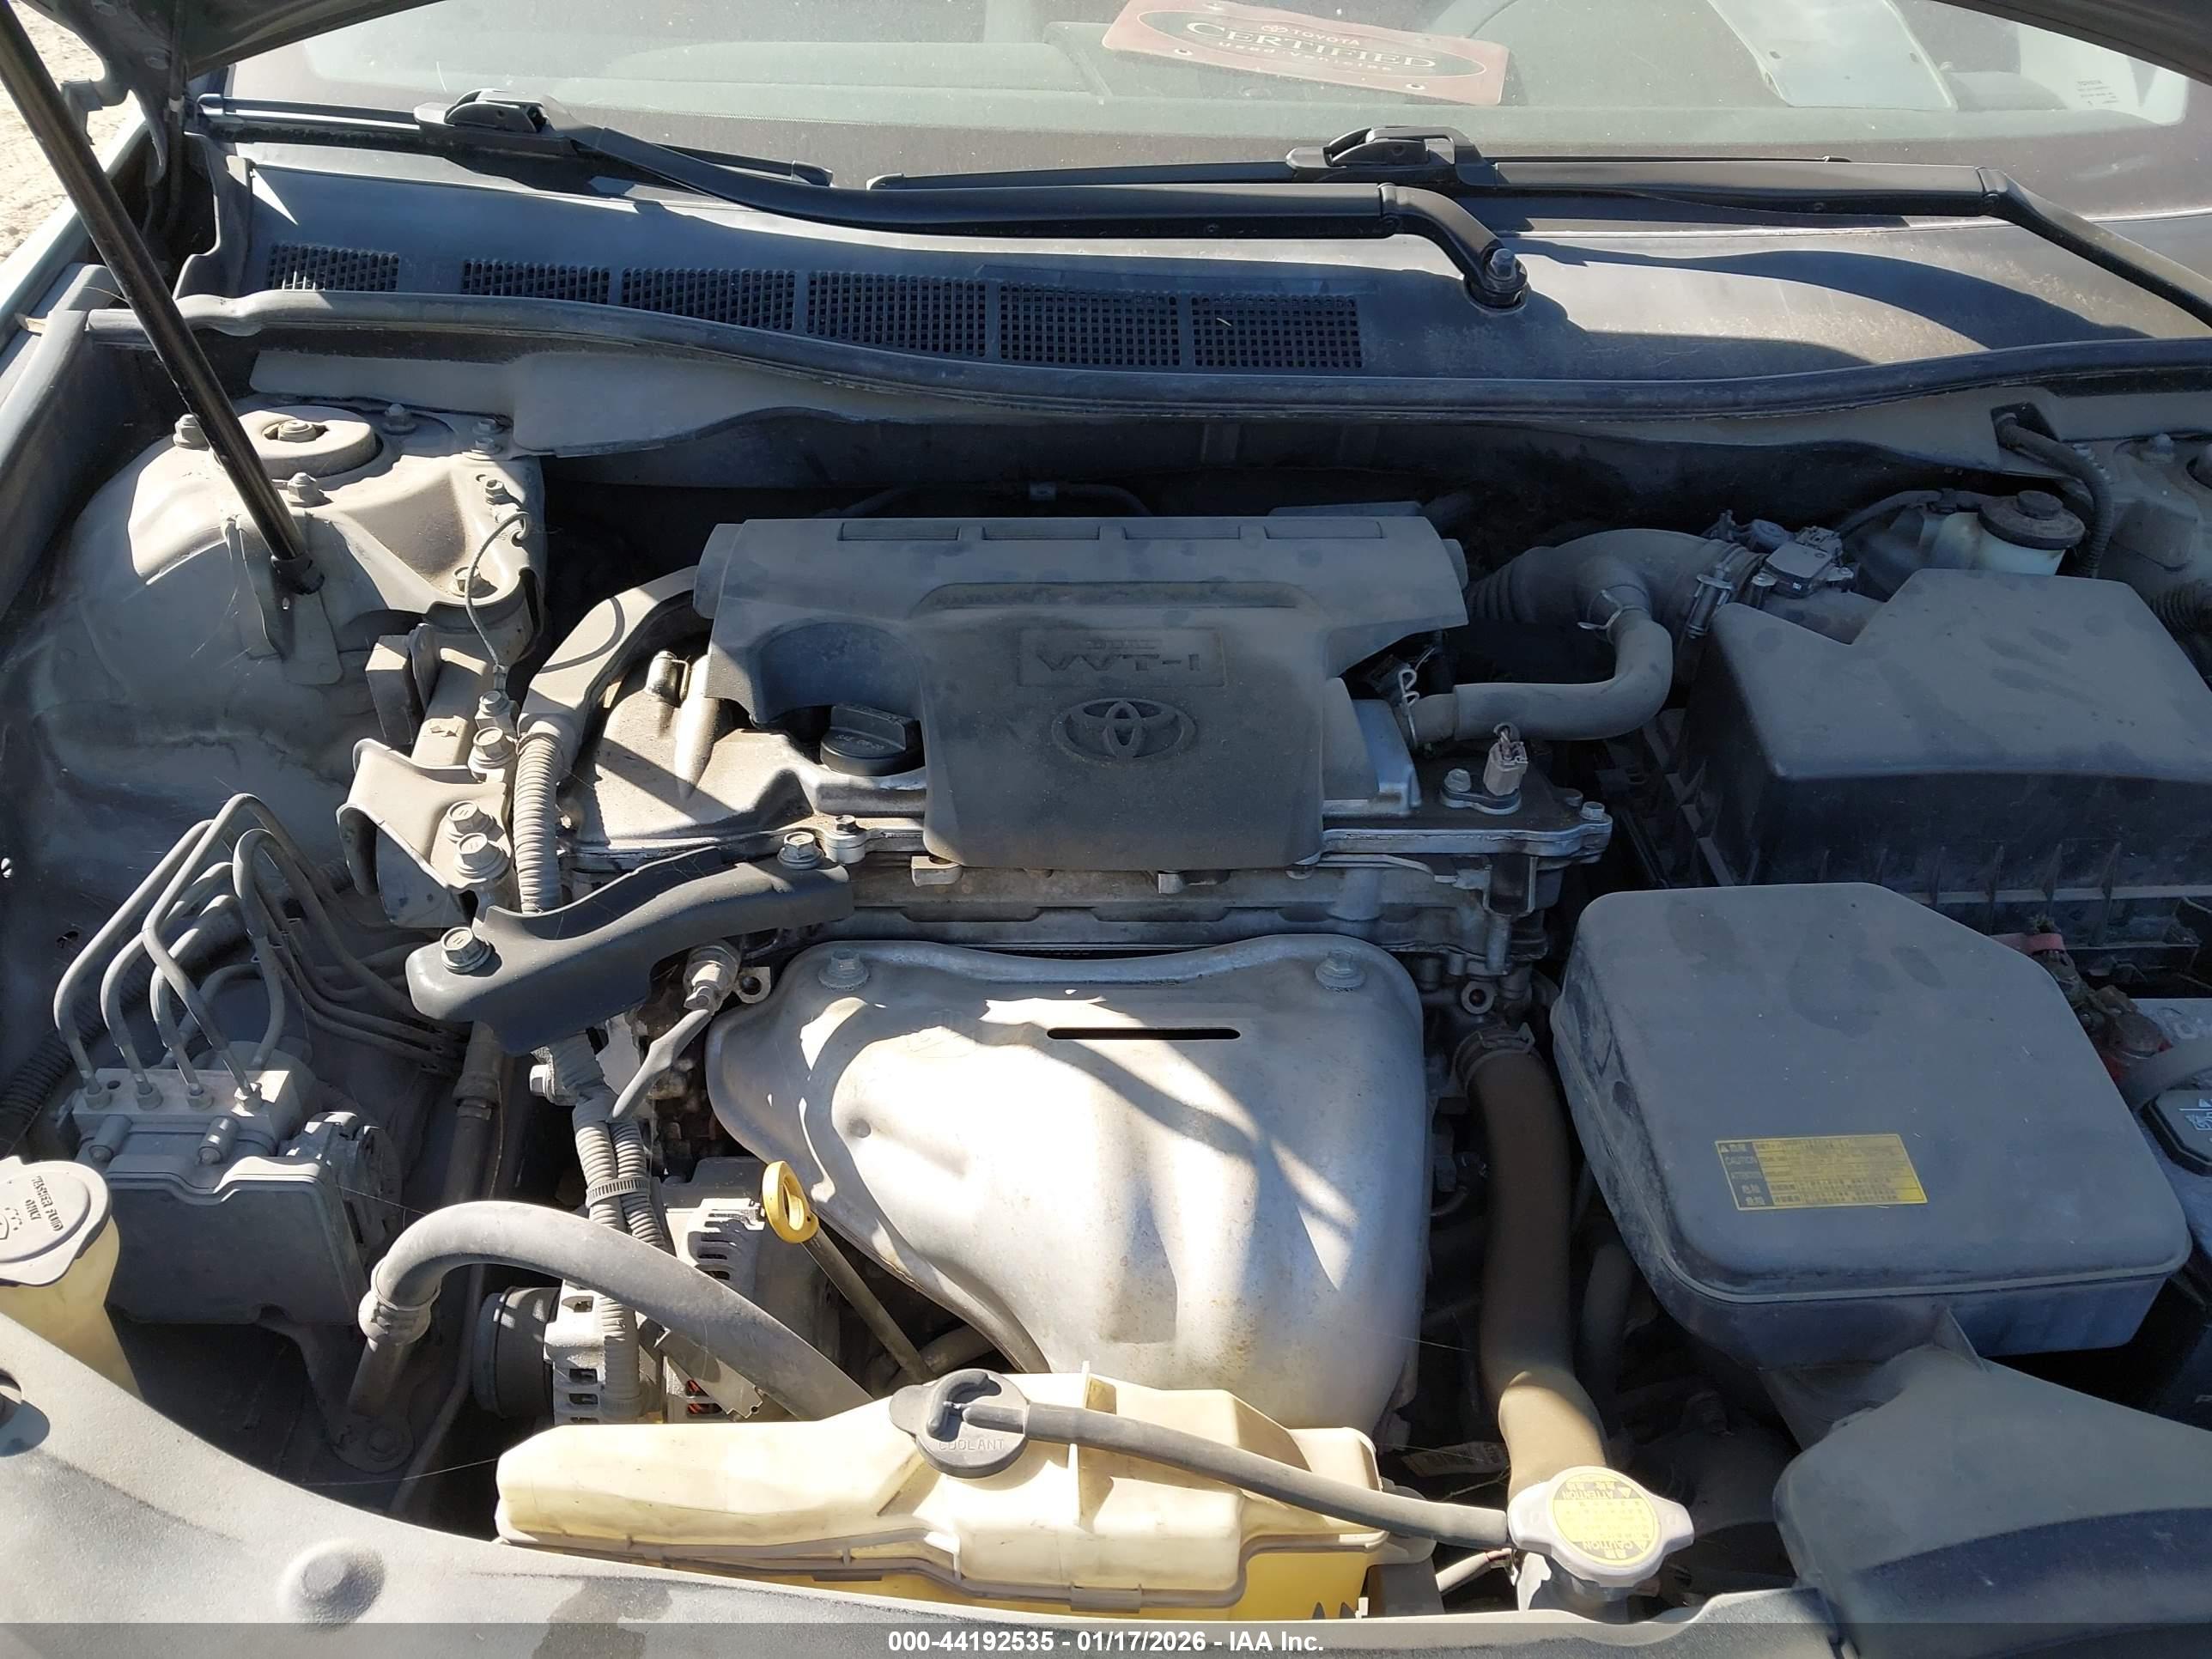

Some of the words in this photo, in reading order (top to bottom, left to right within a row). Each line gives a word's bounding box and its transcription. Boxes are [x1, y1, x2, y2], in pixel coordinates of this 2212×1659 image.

[1186, 21, 1437, 68] CERTIFIED
[1288, 27, 1360, 46] TOYOTA
[1218, 41, 1275, 54] Used
[1290, 52, 1393, 71] Vehicles
[939, 1439, 1004, 1451] COOLANT
